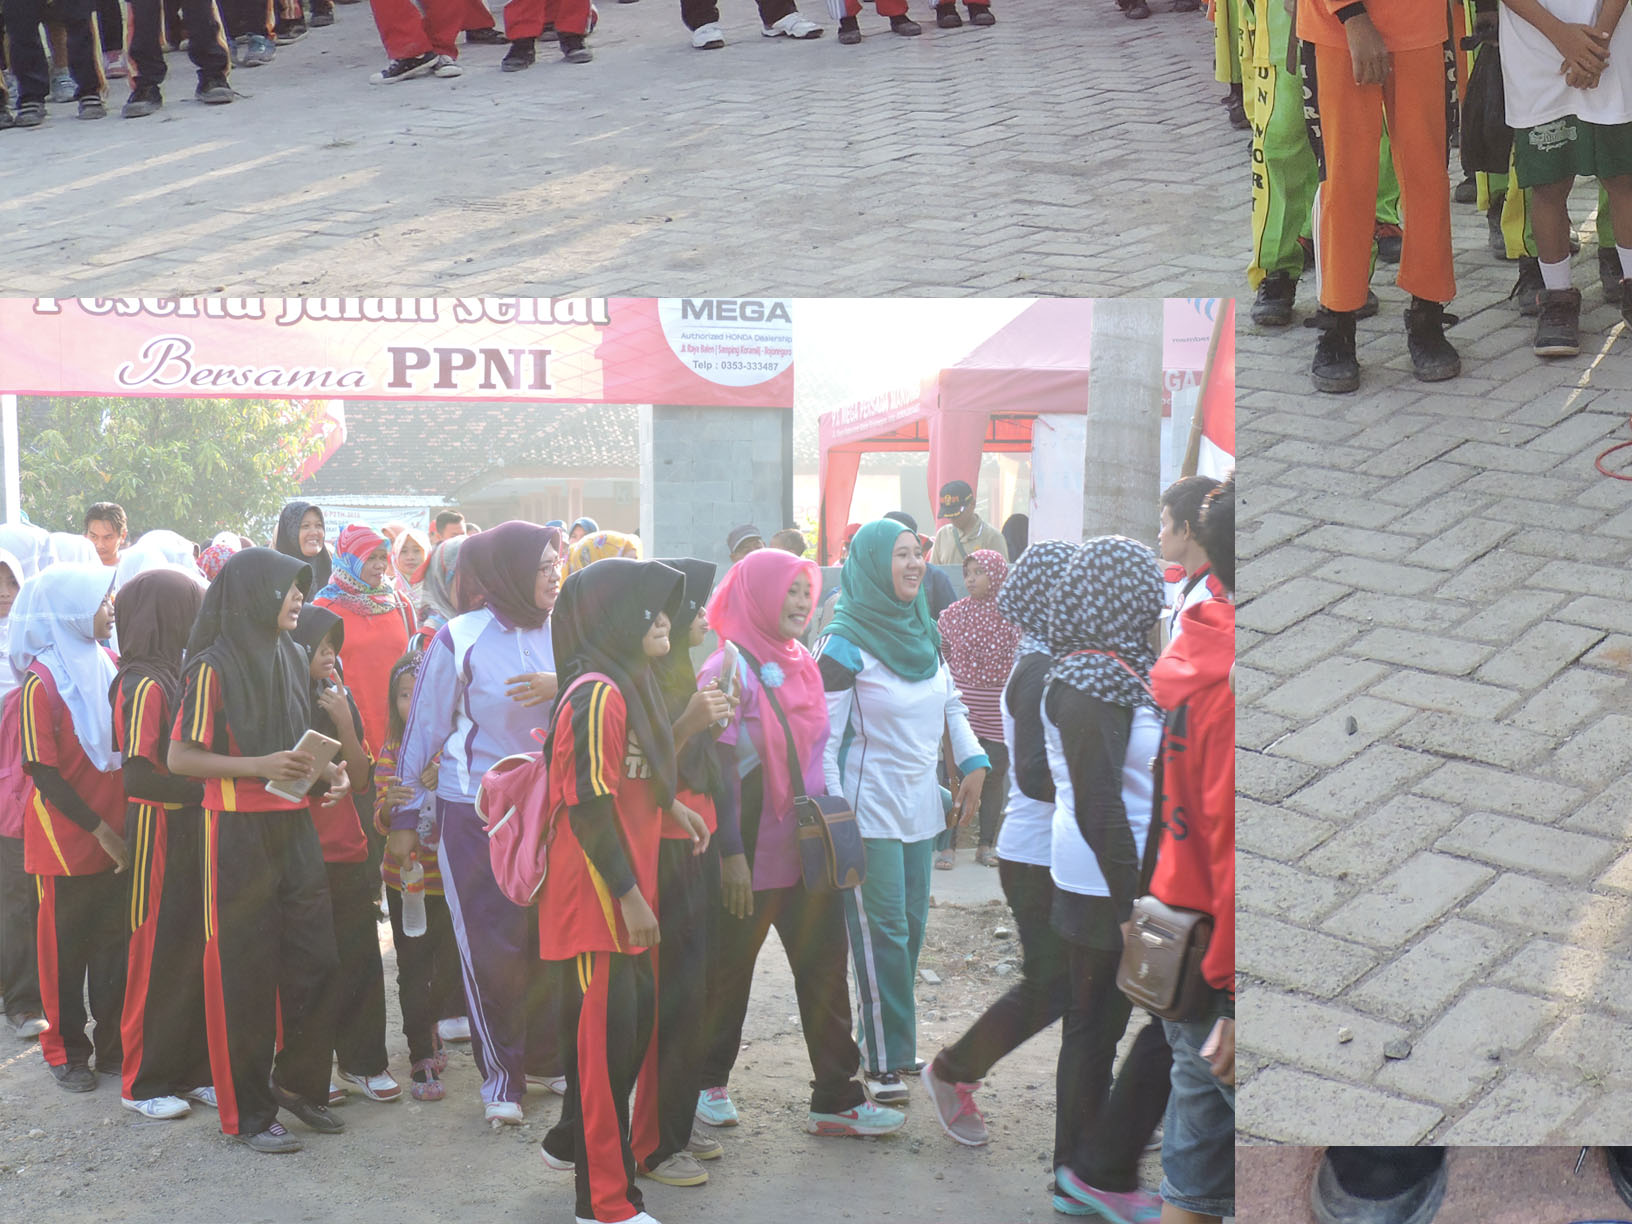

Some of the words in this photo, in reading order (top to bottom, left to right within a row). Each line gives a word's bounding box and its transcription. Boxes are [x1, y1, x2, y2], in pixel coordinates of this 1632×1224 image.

[681, 298, 792, 324] MEGA
[680, 332, 724, 342] Authorized
[726, 333, 753, 342] HONDA
[116, 336, 370, 387] Bersama
[387, 346, 552, 391] PPNI
[693, 360, 713, 370] Telp
